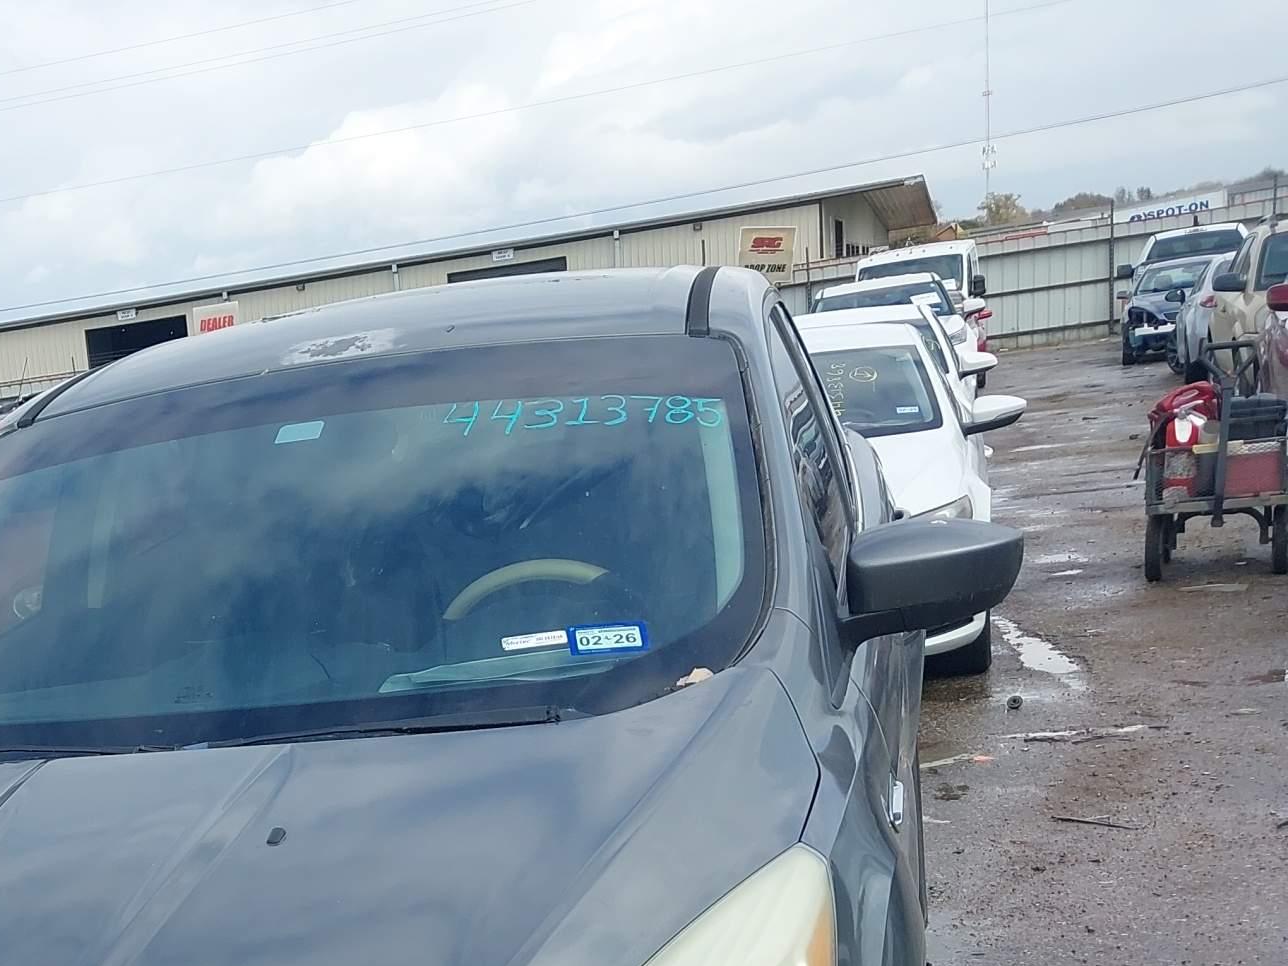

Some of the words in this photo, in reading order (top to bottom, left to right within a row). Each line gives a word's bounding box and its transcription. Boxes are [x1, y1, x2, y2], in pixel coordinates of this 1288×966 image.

[1146, 199, 1209, 220] SPOT-ON
[442, 395, 721, 436] 44313785
[579, 635, 603, 647] 02
[612, 632, 638, 644] 26
